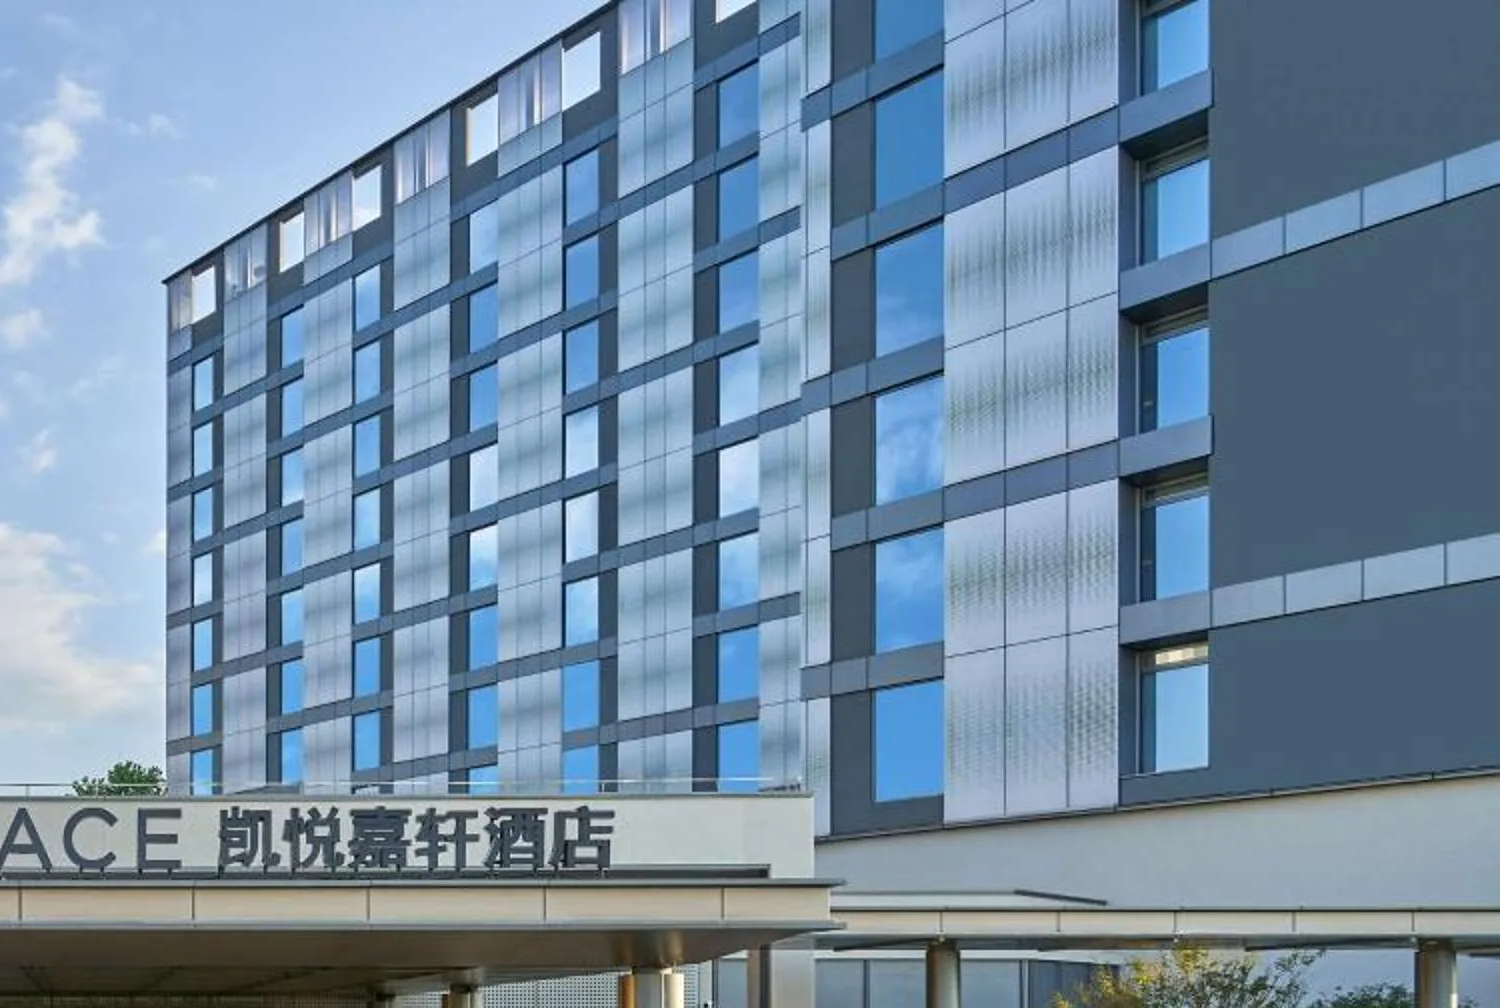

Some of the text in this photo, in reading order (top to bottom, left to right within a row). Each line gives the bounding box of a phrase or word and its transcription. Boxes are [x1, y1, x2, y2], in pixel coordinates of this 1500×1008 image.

[218, 806, 615, 870] 凯悦嘉轩酒店
